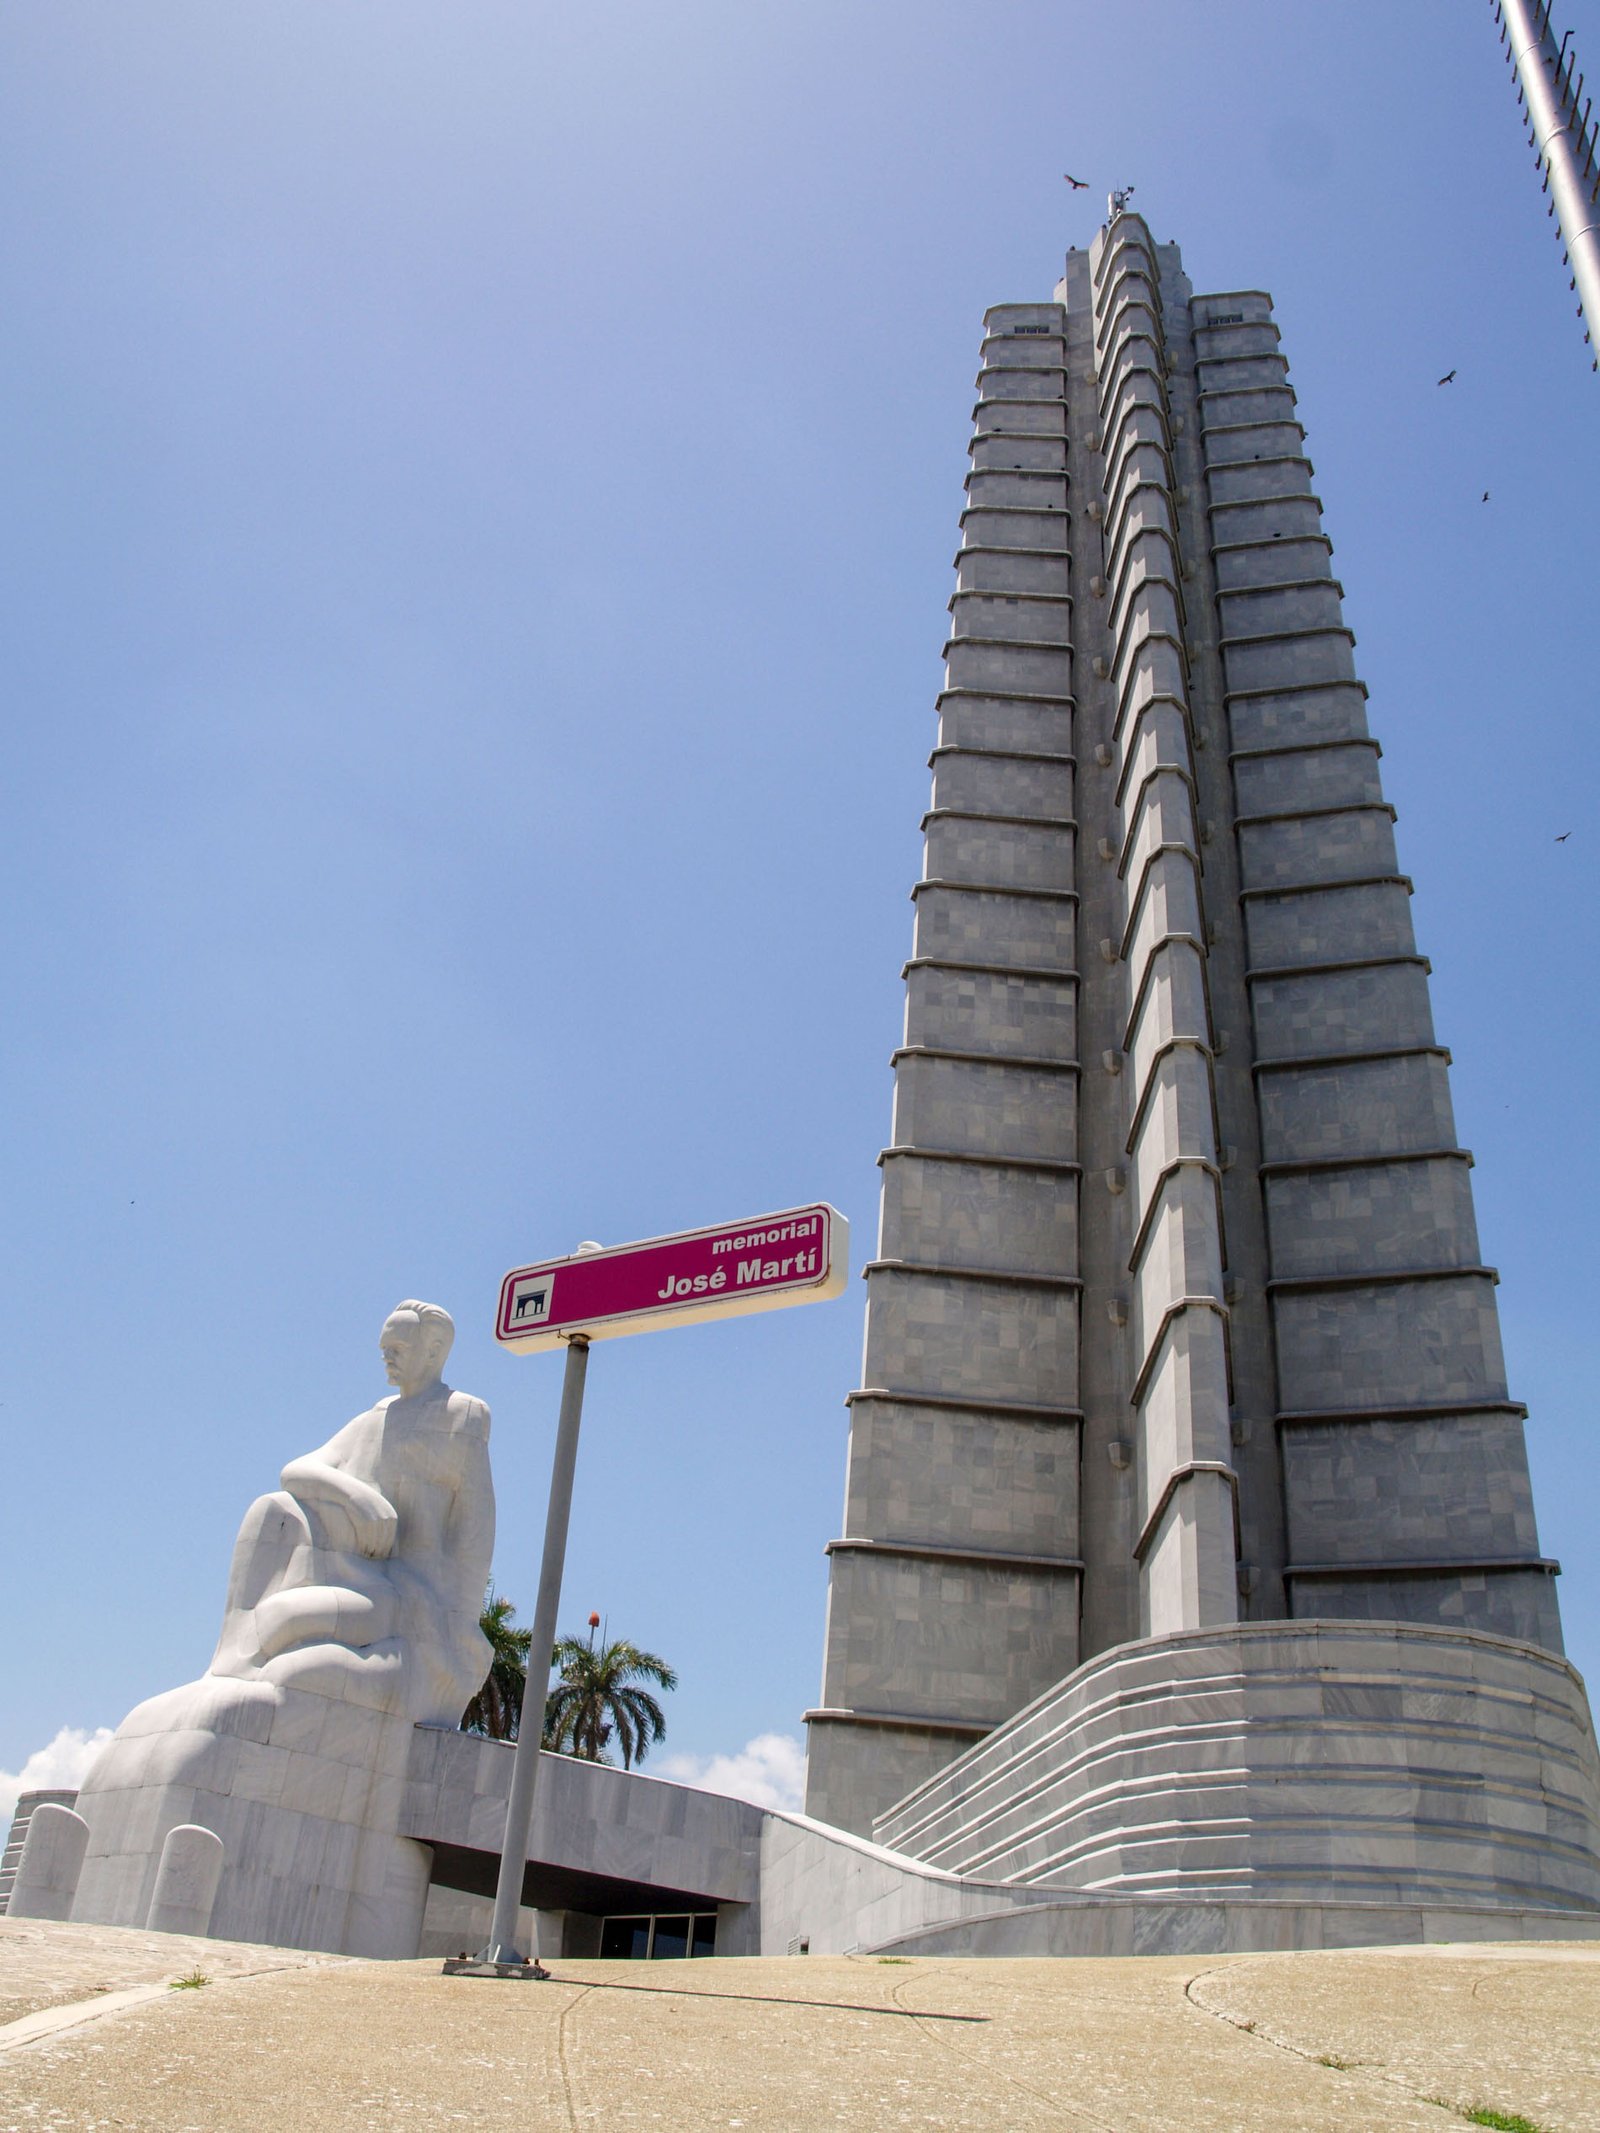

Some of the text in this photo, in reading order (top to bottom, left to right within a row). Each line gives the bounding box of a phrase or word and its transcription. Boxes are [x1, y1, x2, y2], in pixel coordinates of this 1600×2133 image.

[712, 1217, 818, 1255] memorial
[657, 1247, 816, 1299] José Martí
